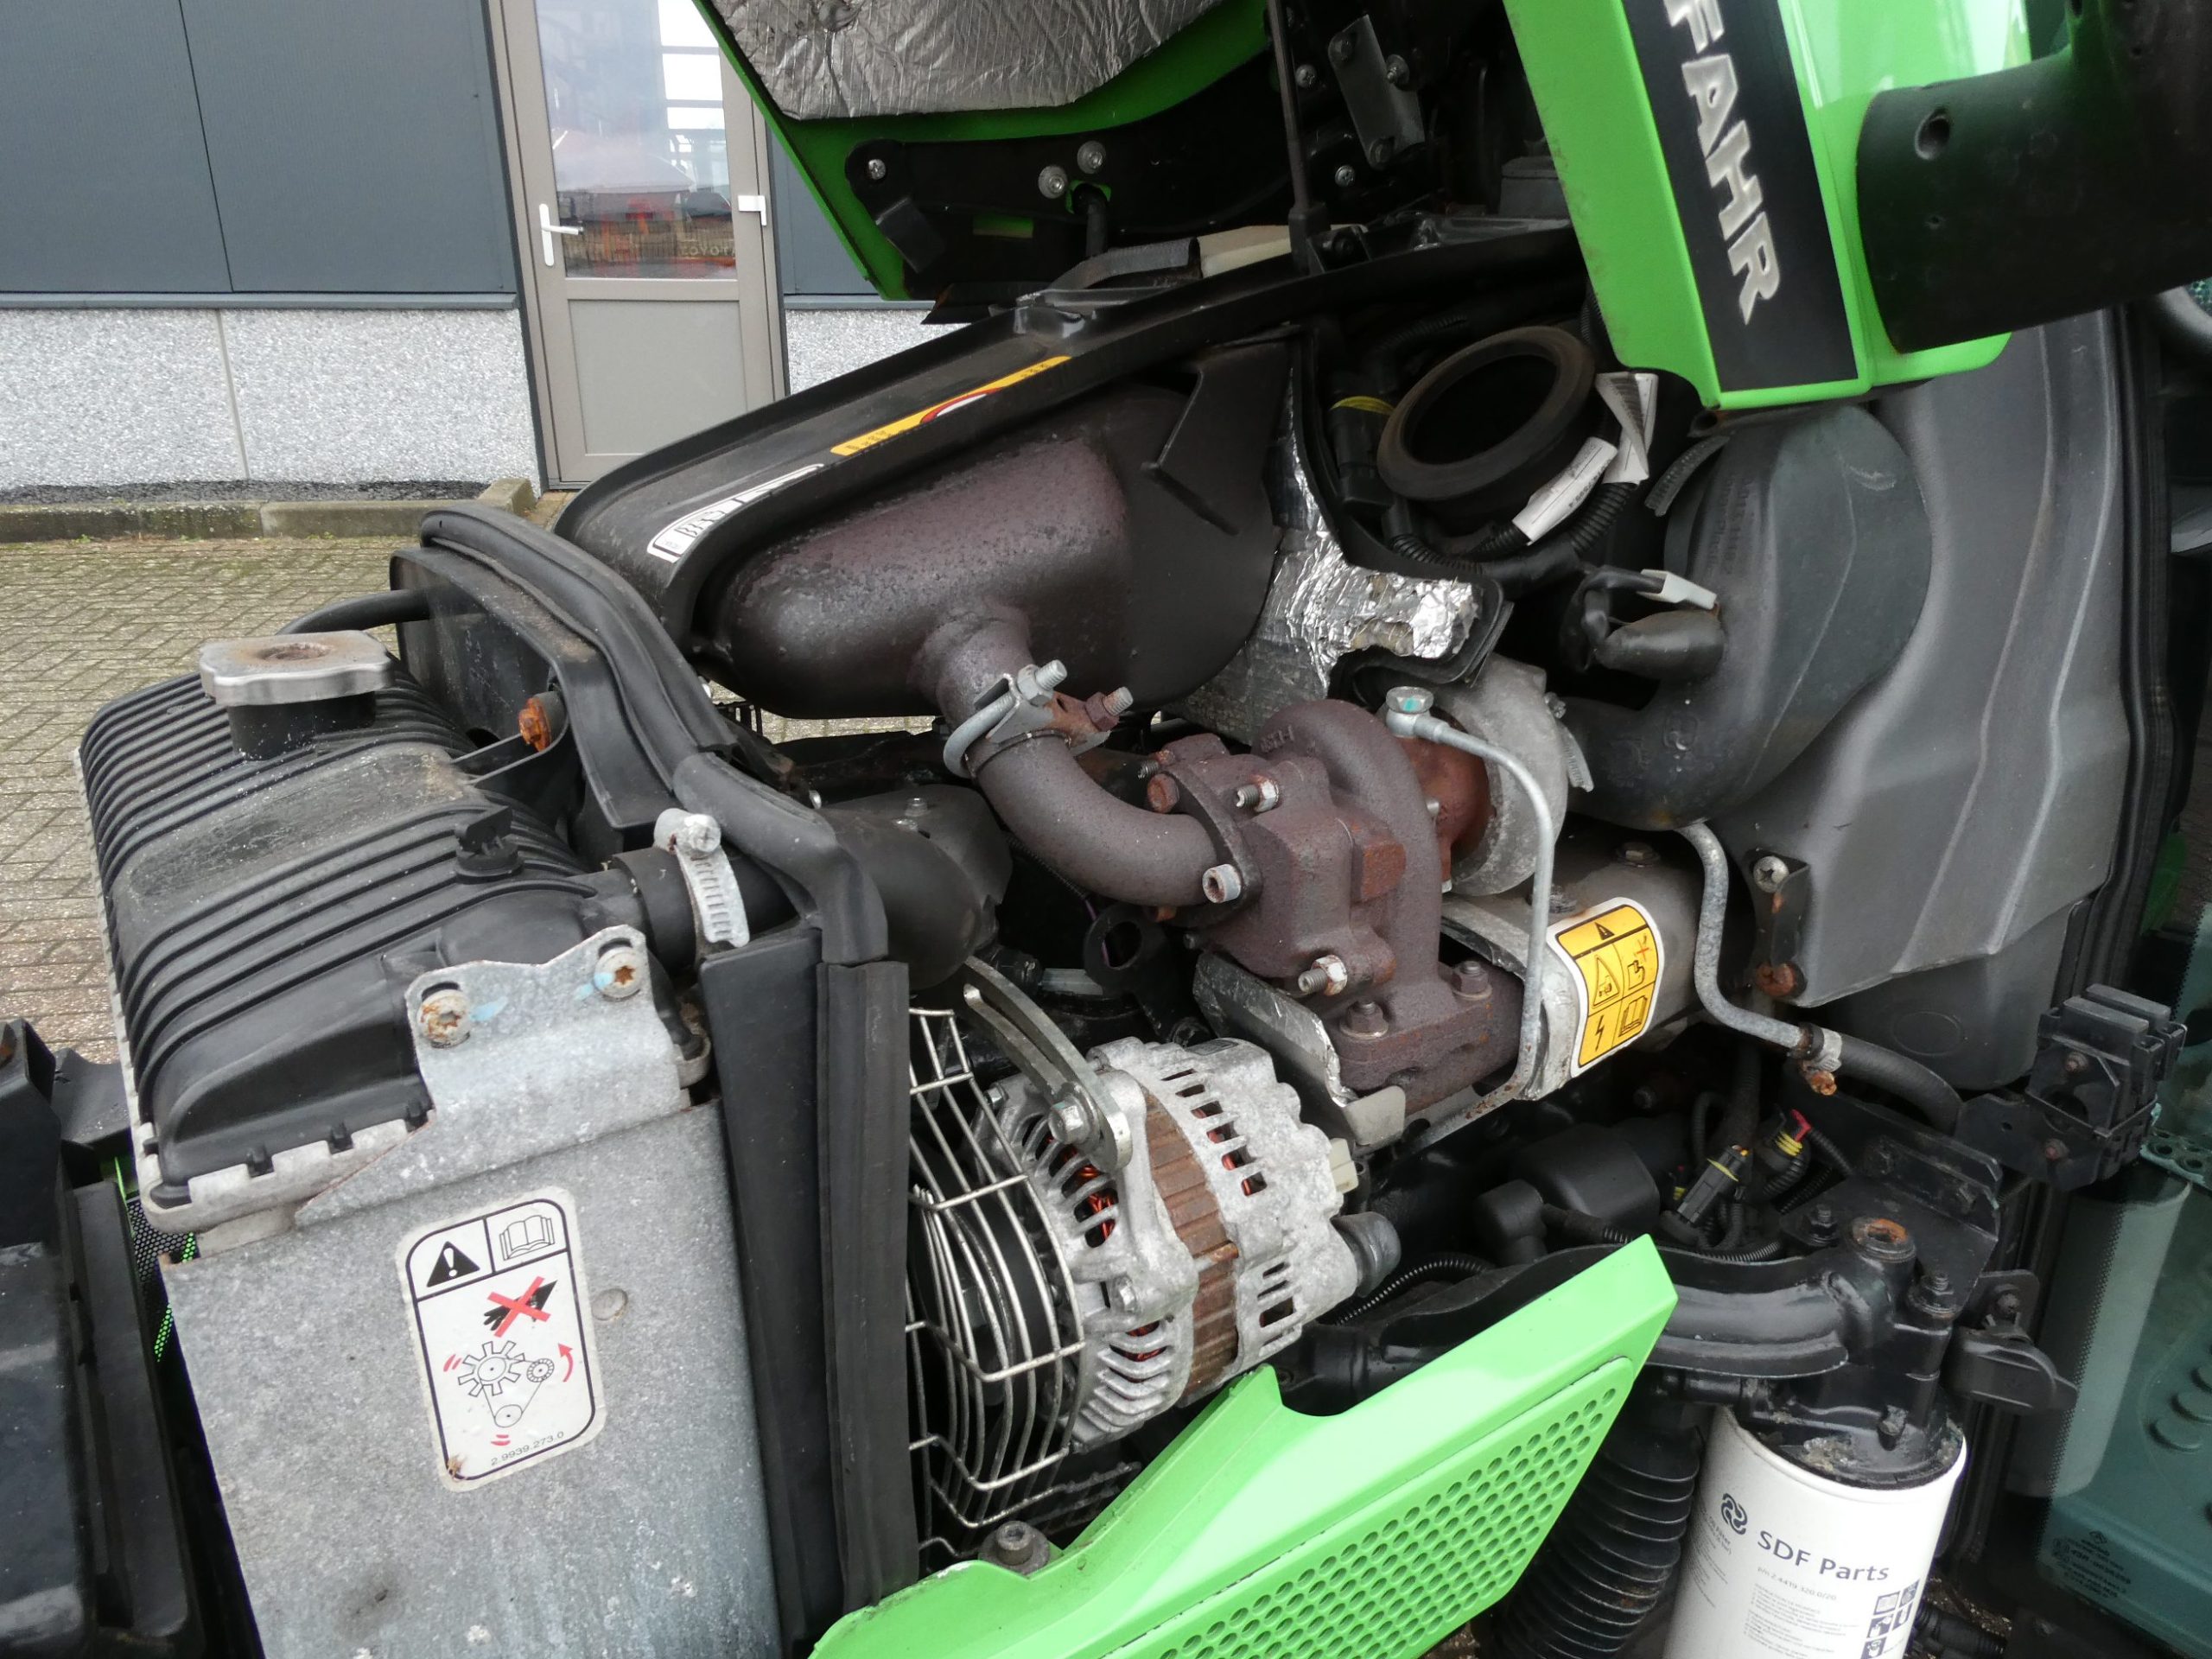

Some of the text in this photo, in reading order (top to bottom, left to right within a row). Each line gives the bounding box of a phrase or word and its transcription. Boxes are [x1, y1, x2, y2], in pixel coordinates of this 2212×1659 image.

[1663, 0, 1780, 326] FAHR
[491, 1431, 564, 1466] 2.9939.273.0
[1757, 1529, 1812, 1567] SDF
[1819, 1557, 1890, 1581] Parts
